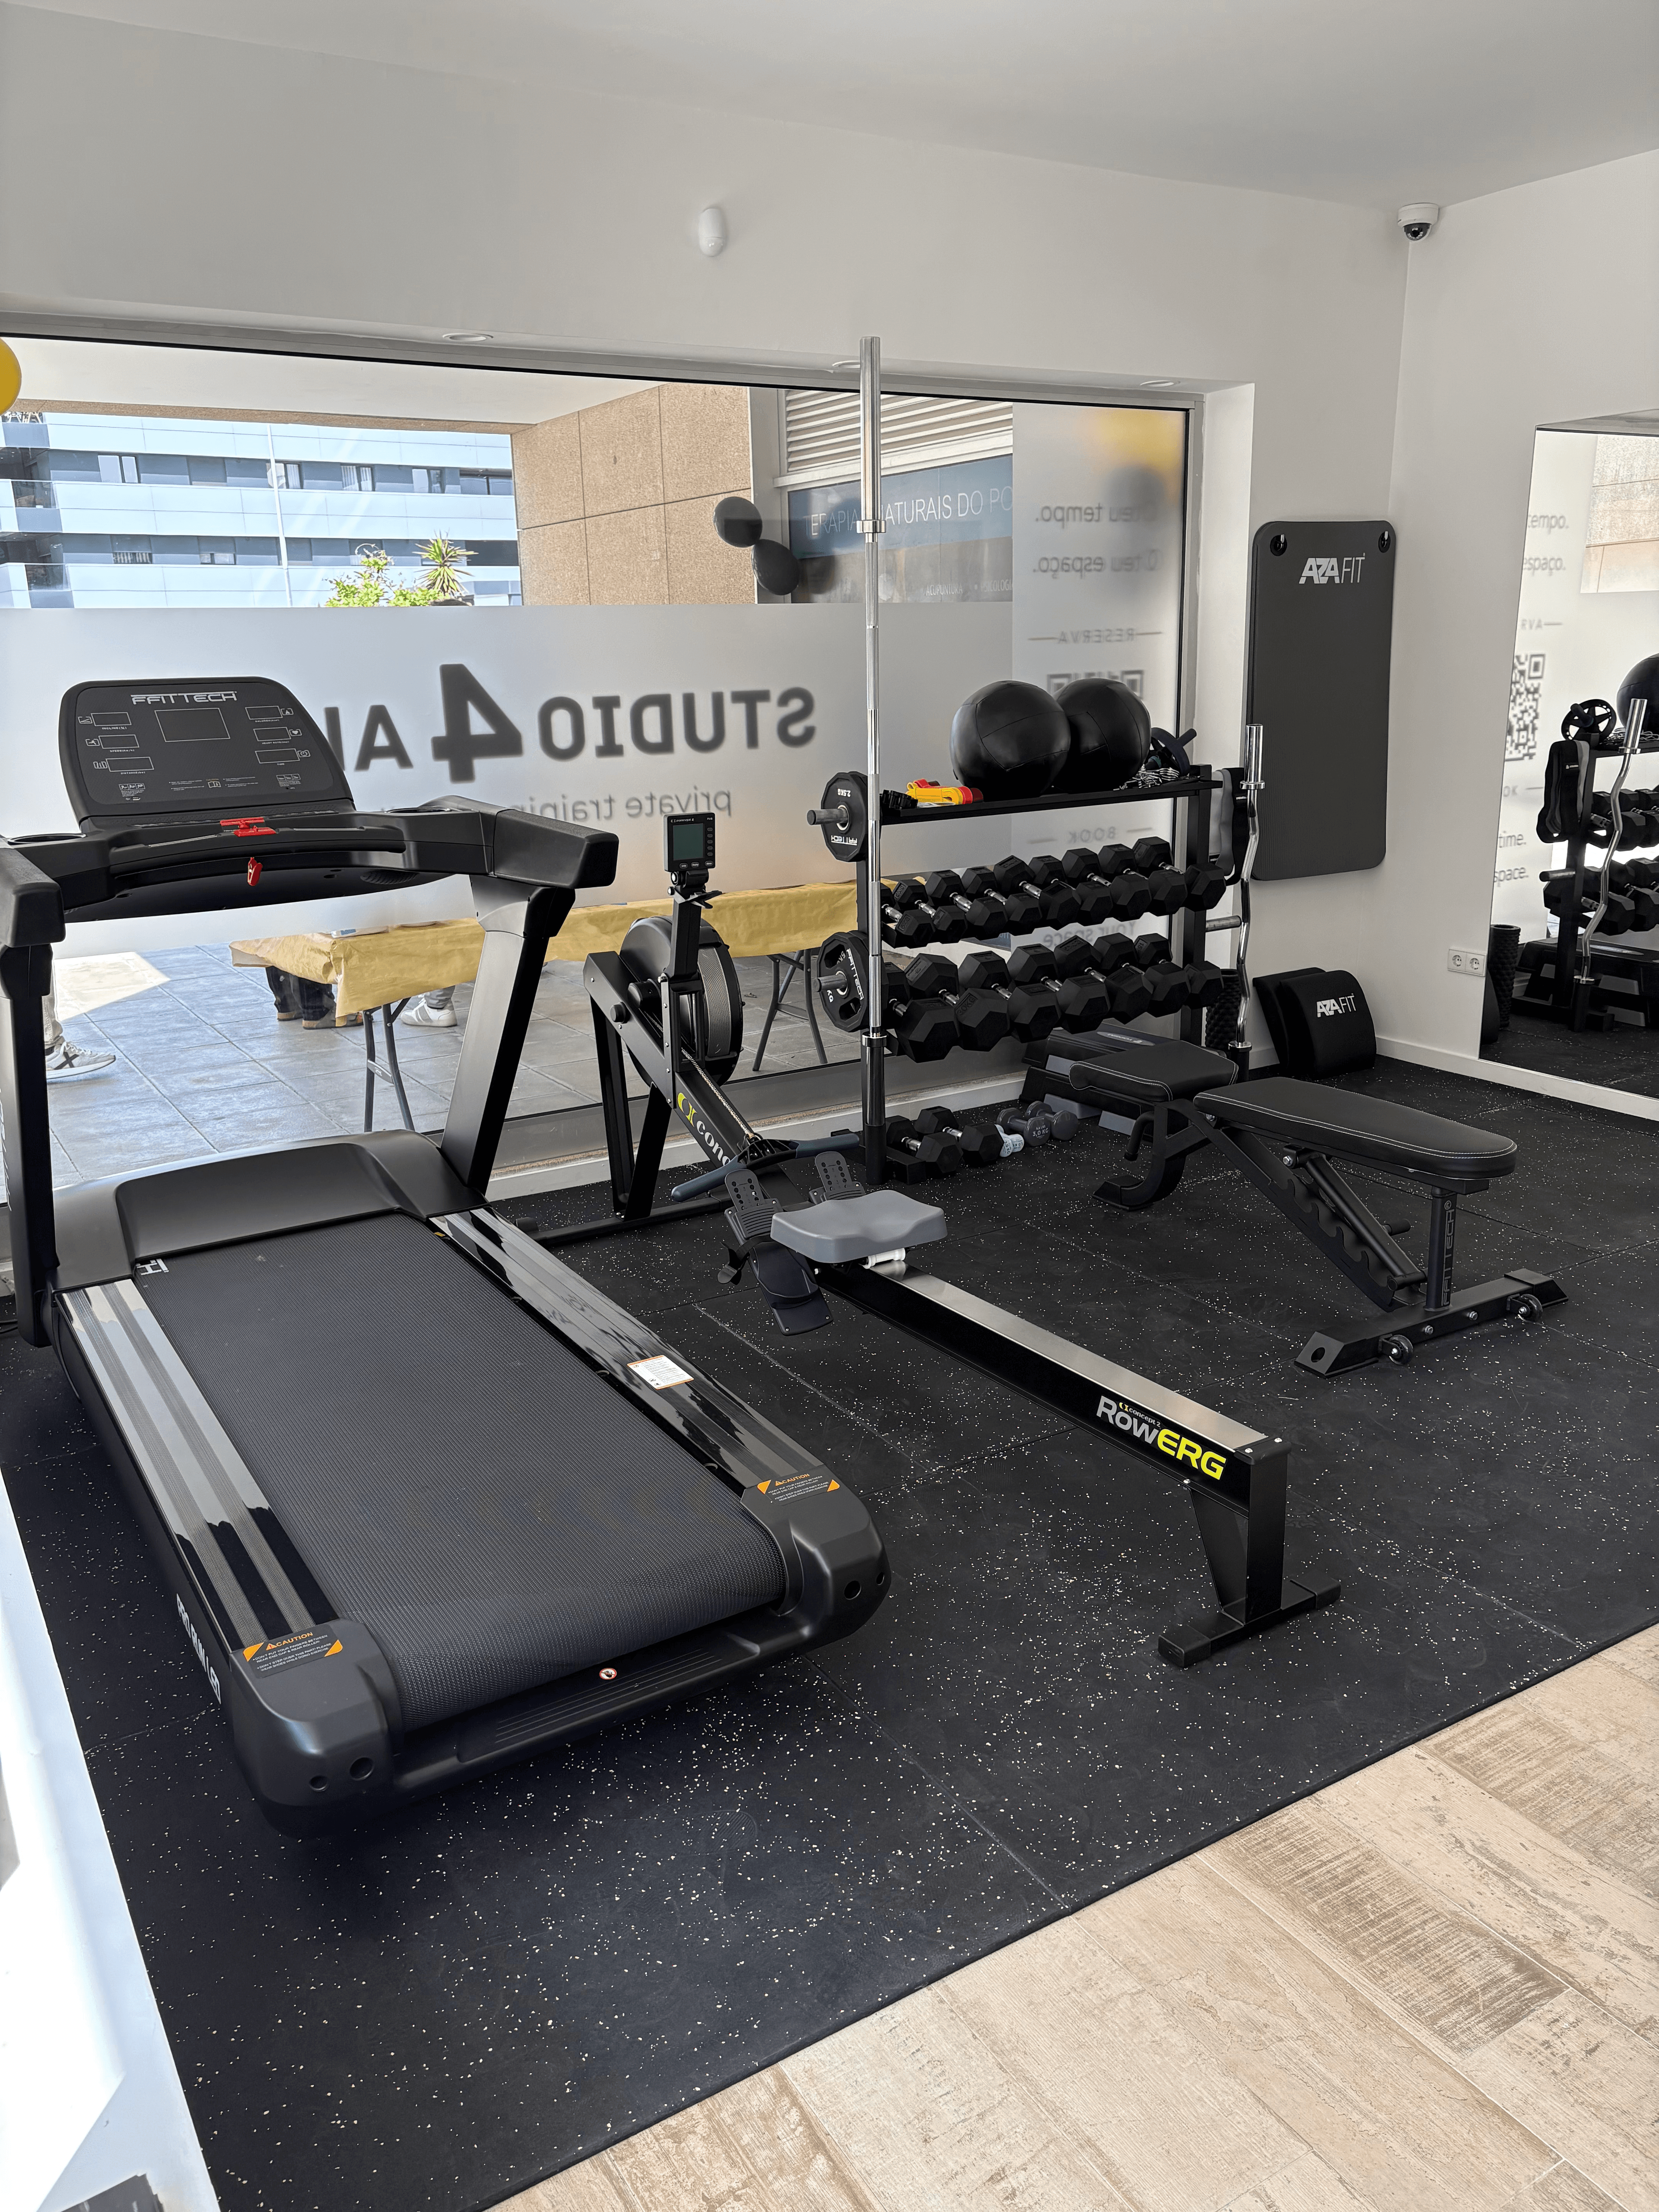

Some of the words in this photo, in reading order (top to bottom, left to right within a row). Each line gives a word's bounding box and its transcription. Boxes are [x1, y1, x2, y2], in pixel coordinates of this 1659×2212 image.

[958, 490, 983, 517] DO
[926, 583, 963, 597] ACUPUNTURA
[130, 691, 237, 705] FFITTECH
[782, 1473, 810, 1484] CAUTION
[276, 1632, 313, 1647] CAUTION
